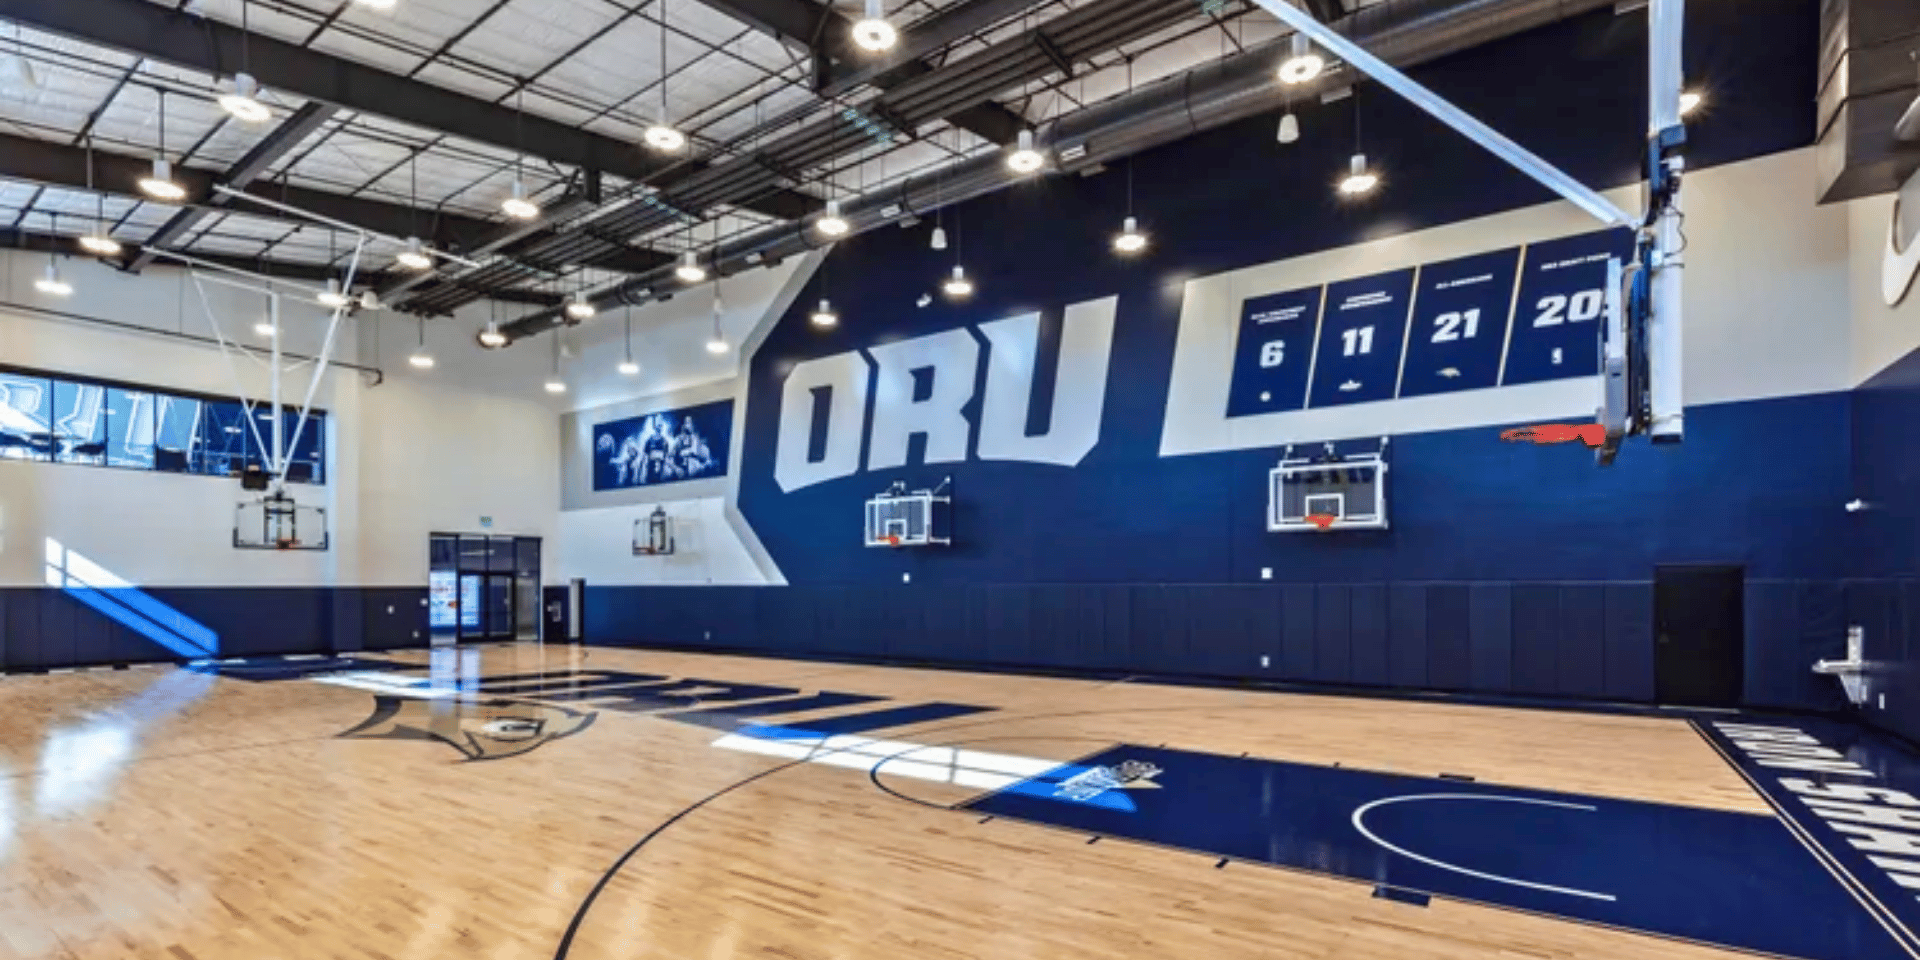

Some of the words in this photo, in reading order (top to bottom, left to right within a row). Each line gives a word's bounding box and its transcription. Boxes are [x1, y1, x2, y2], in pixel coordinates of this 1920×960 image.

[1430, 308, 1481, 344] 21
[1533, 288, 1603, 328] 20
[1259, 340, 1284, 368] 6
[1341, 325, 1375, 357] 11
[774, 295, 1118, 493] ORU
[1711, 720, 1877, 778] IRON
